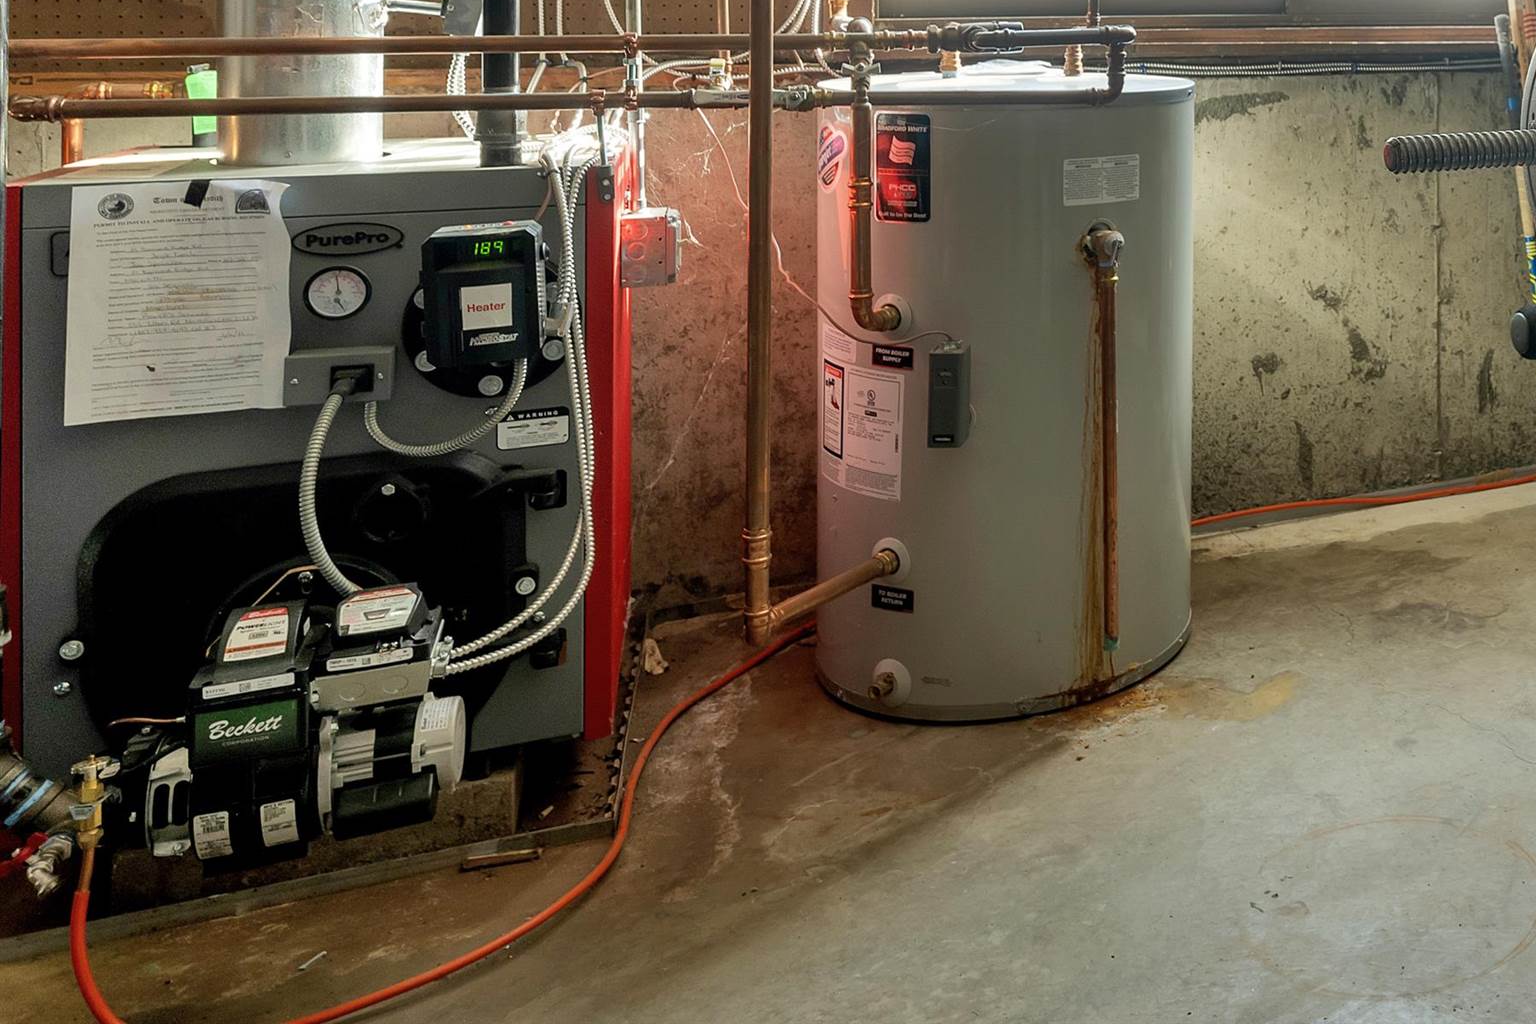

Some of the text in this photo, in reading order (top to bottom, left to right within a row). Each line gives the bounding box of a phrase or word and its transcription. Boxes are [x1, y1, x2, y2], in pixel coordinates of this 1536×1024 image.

[907, 125, 929, 133] WHITE
[305, 231, 390, 247] PurePro
[473, 240, 503, 255] 189
[466, 301, 506, 313] Heater
[875, 347, 910, 357] FROM BOILER
[518, 410, 559, 419] WARNING
[881, 597, 904, 606] RETURN
[208, 715, 283, 741] Beckett
